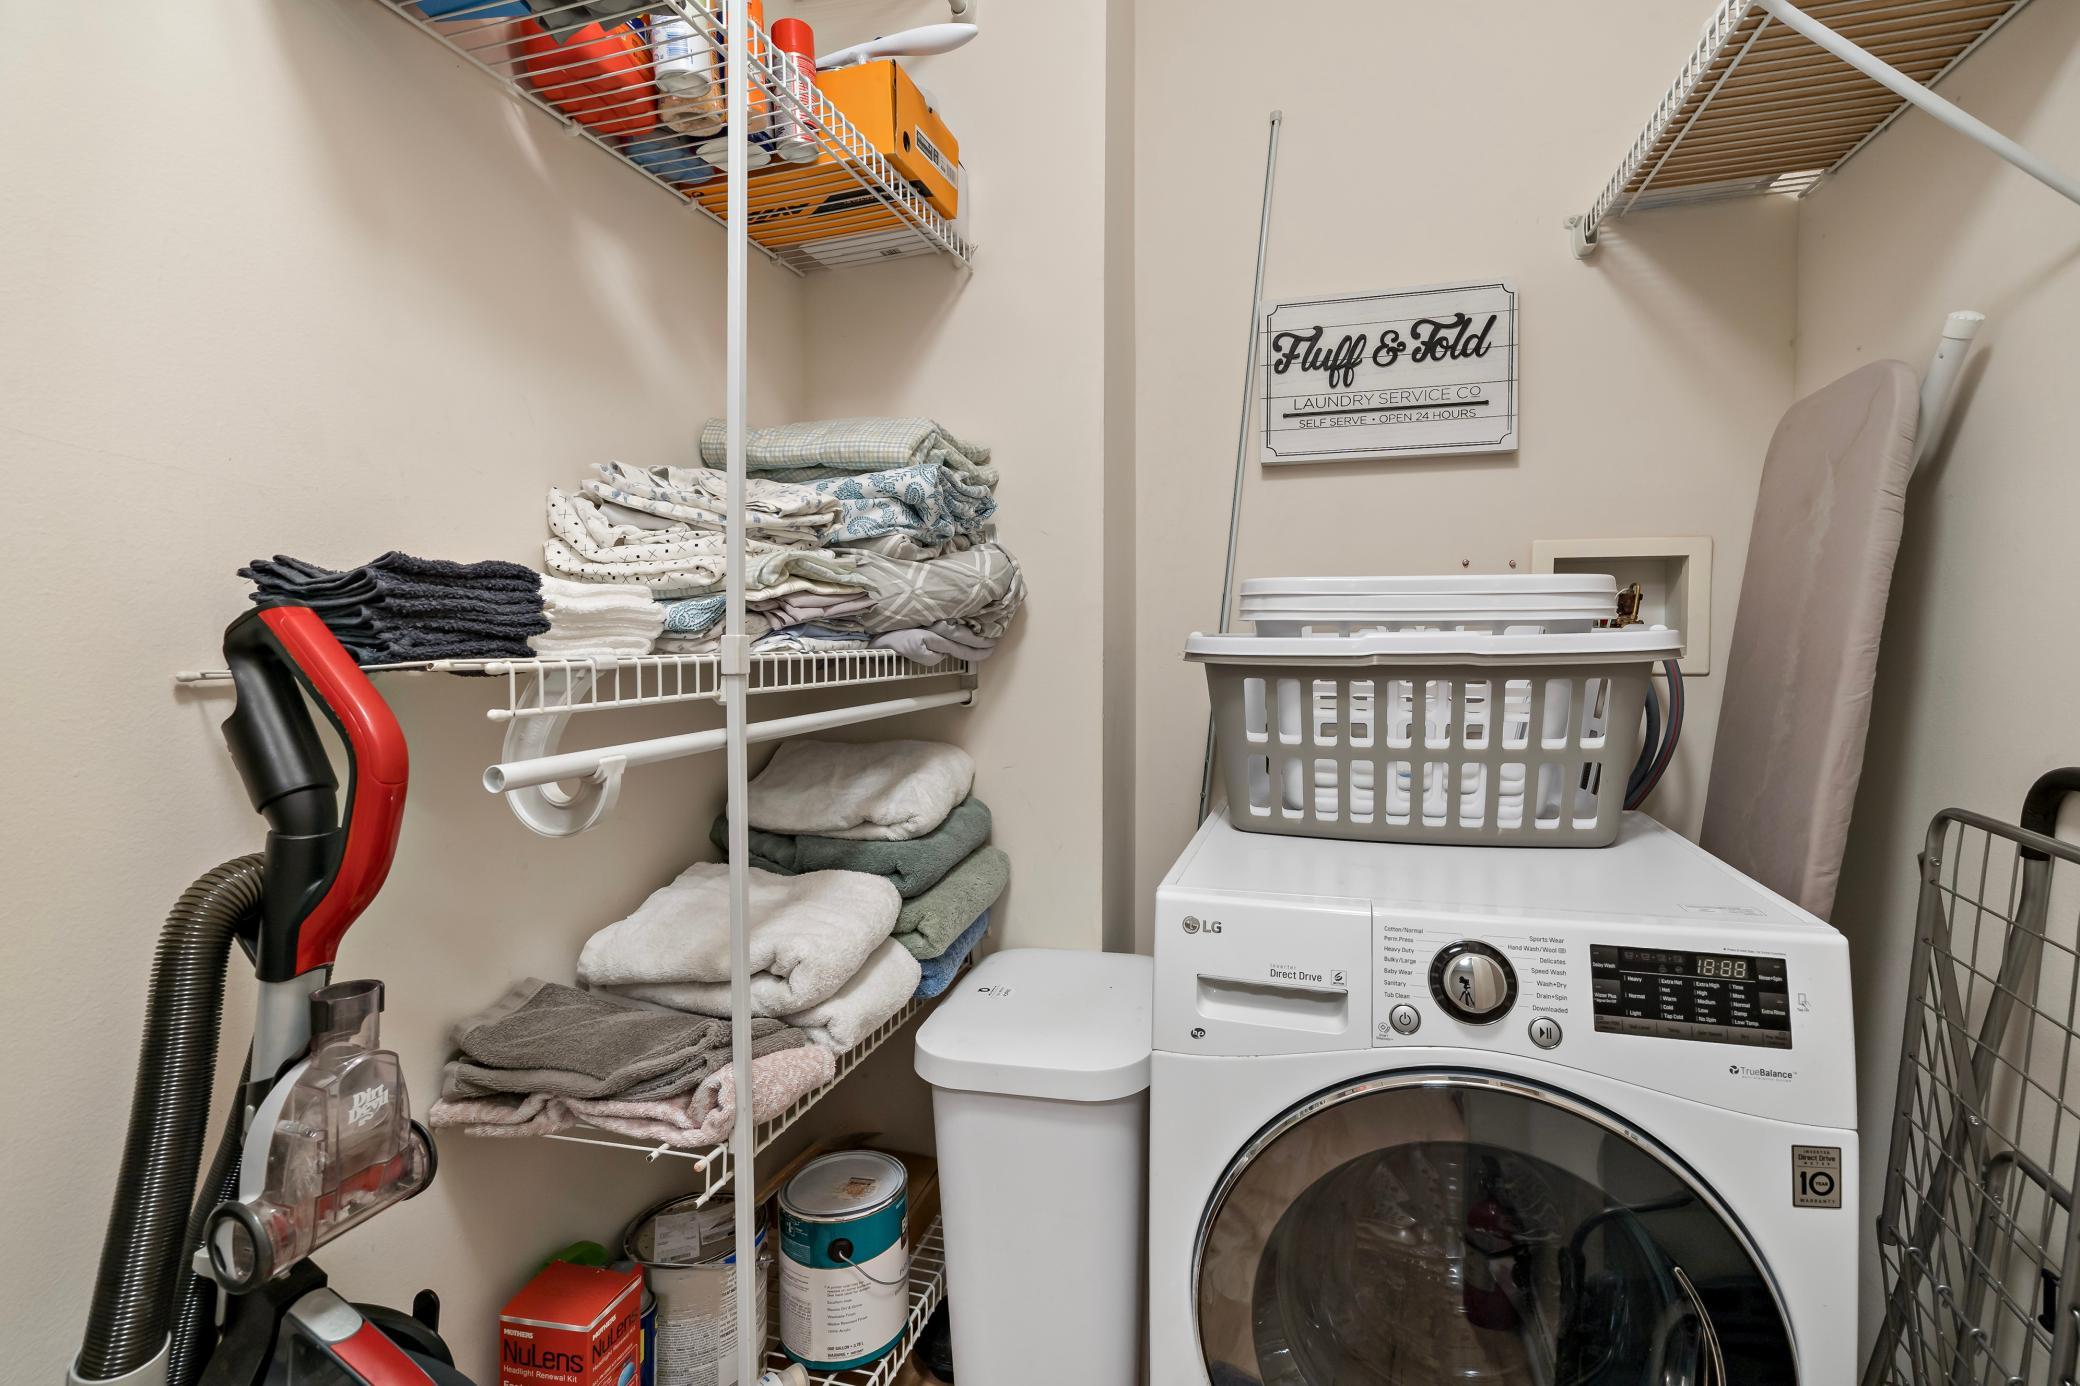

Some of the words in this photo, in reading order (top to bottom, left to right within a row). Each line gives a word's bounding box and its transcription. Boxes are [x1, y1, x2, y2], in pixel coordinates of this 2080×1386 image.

[1272, 325, 1367, 389] Fluff
[1372, 329, 1407, 368] &
[1410, 312, 1498, 363] Fold
[1293, 392, 1375, 411] LAUNDRY
[1378, 387, 1451, 406] SERVICE
[1298, 418, 1327, 429] SELF
[1329, 415, 1368, 427] SERVE
[1379, 412, 1413, 423] OPEN
[1415, 410, 1429, 421] 24
[1432, 408, 1477, 420] HOURS
[1202, 919, 1222, 934] LG
[1383, 925, 1424, 934] Cotton/Normal
[1529, 935, 1548, 943] Sports
[1383, 946, 1401, 954] Heavy
[1523, 945, 1557, 953] Wash/Wool
[1539, 957, 1567, 965] Delicates
[1270, 968, 1297, 980] Direct
[1298, 971, 1322, 982] Drive
[1383, 967, 1398, 975] Baby
[1531, 967, 1549, 975] Speed
[1627, 974, 1642, 982] Heavy
[1383, 980, 1407, 988] Sanitary
[1536, 980, 1567, 990] Wash+Dry
[1536, 992, 1568, 1001] Drain+Spin
[1532, 1004, 1569, 1014] Downloaded
[1740, 1066, 1793, 1079] TrueBalance
[353, 1084, 386, 1107] Dirt
[349, 1088, 389, 1126] Devil
[1798, 1153, 1818, 1161] Direct
[1800, 1171, 1835, 1196] 10
[592, 1313, 617, 1341] MOTHERS
[503, 1328, 534, 1339] MOTHERS
[592, 1307, 639, 1364] NuLens
[503, 1339, 584, 1374] NuLens
[503, 1365, 534, 1378] Headlight
[535, 1371, 566, 1382] Renewal
[567, 1375, 577, 1383] Kit
